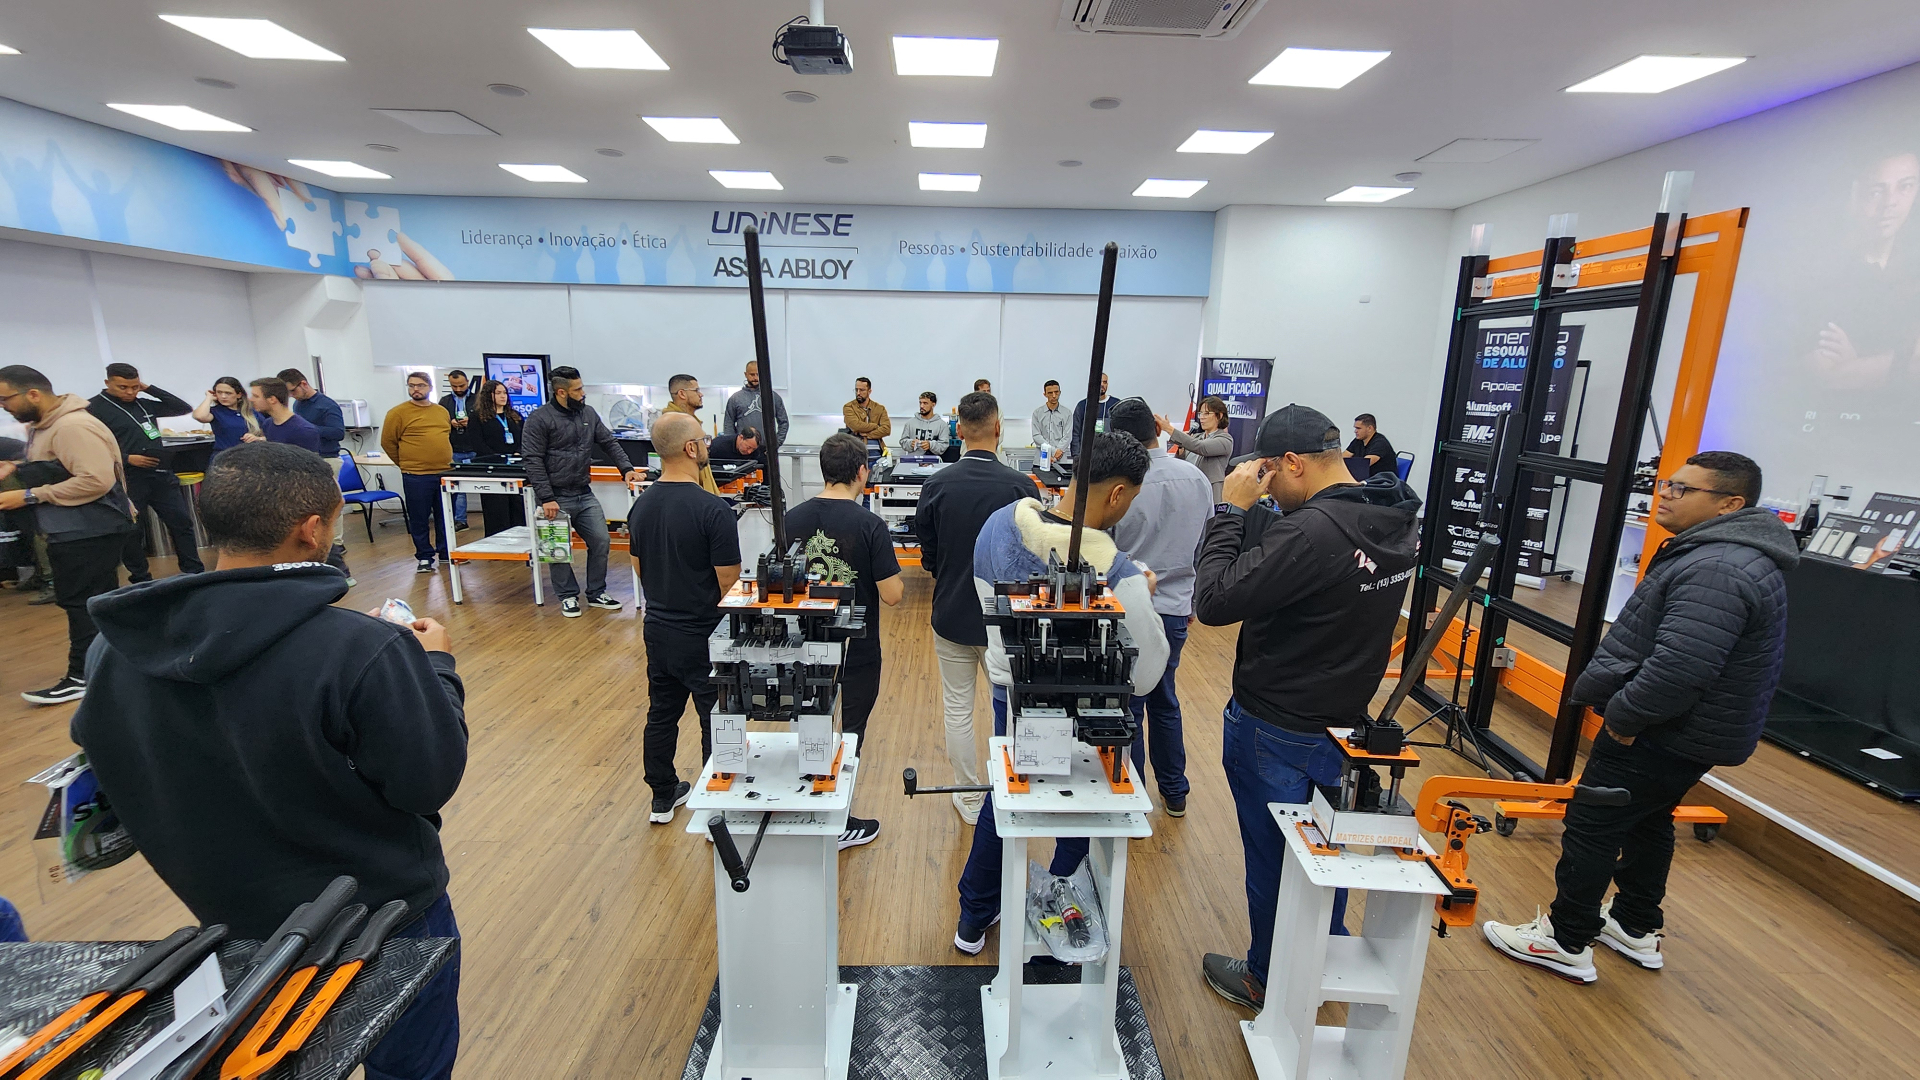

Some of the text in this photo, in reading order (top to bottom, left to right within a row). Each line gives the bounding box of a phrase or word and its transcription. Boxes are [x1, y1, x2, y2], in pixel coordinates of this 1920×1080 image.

[461, 229, 667, 251] Liderança Inovação Ética
[899, 240, 1157, 259] Pessoas Sustentabilidade aixão
[778, 258, 854, 280] ABLOY
[1218, 361, 1255, 376] SEMANA
[1482, 358, 1499, 368] DE
[1207, 380, 1262, 397] QUALIFICAÇÃO
[1226, 403, 1253, 417] ADRIAS
[1466, 400, 1512, 412] Alumisoft
[1335, 832, 1375, 844] MATRIZES
[1376, 834, 1413, 846] CARDEAL
